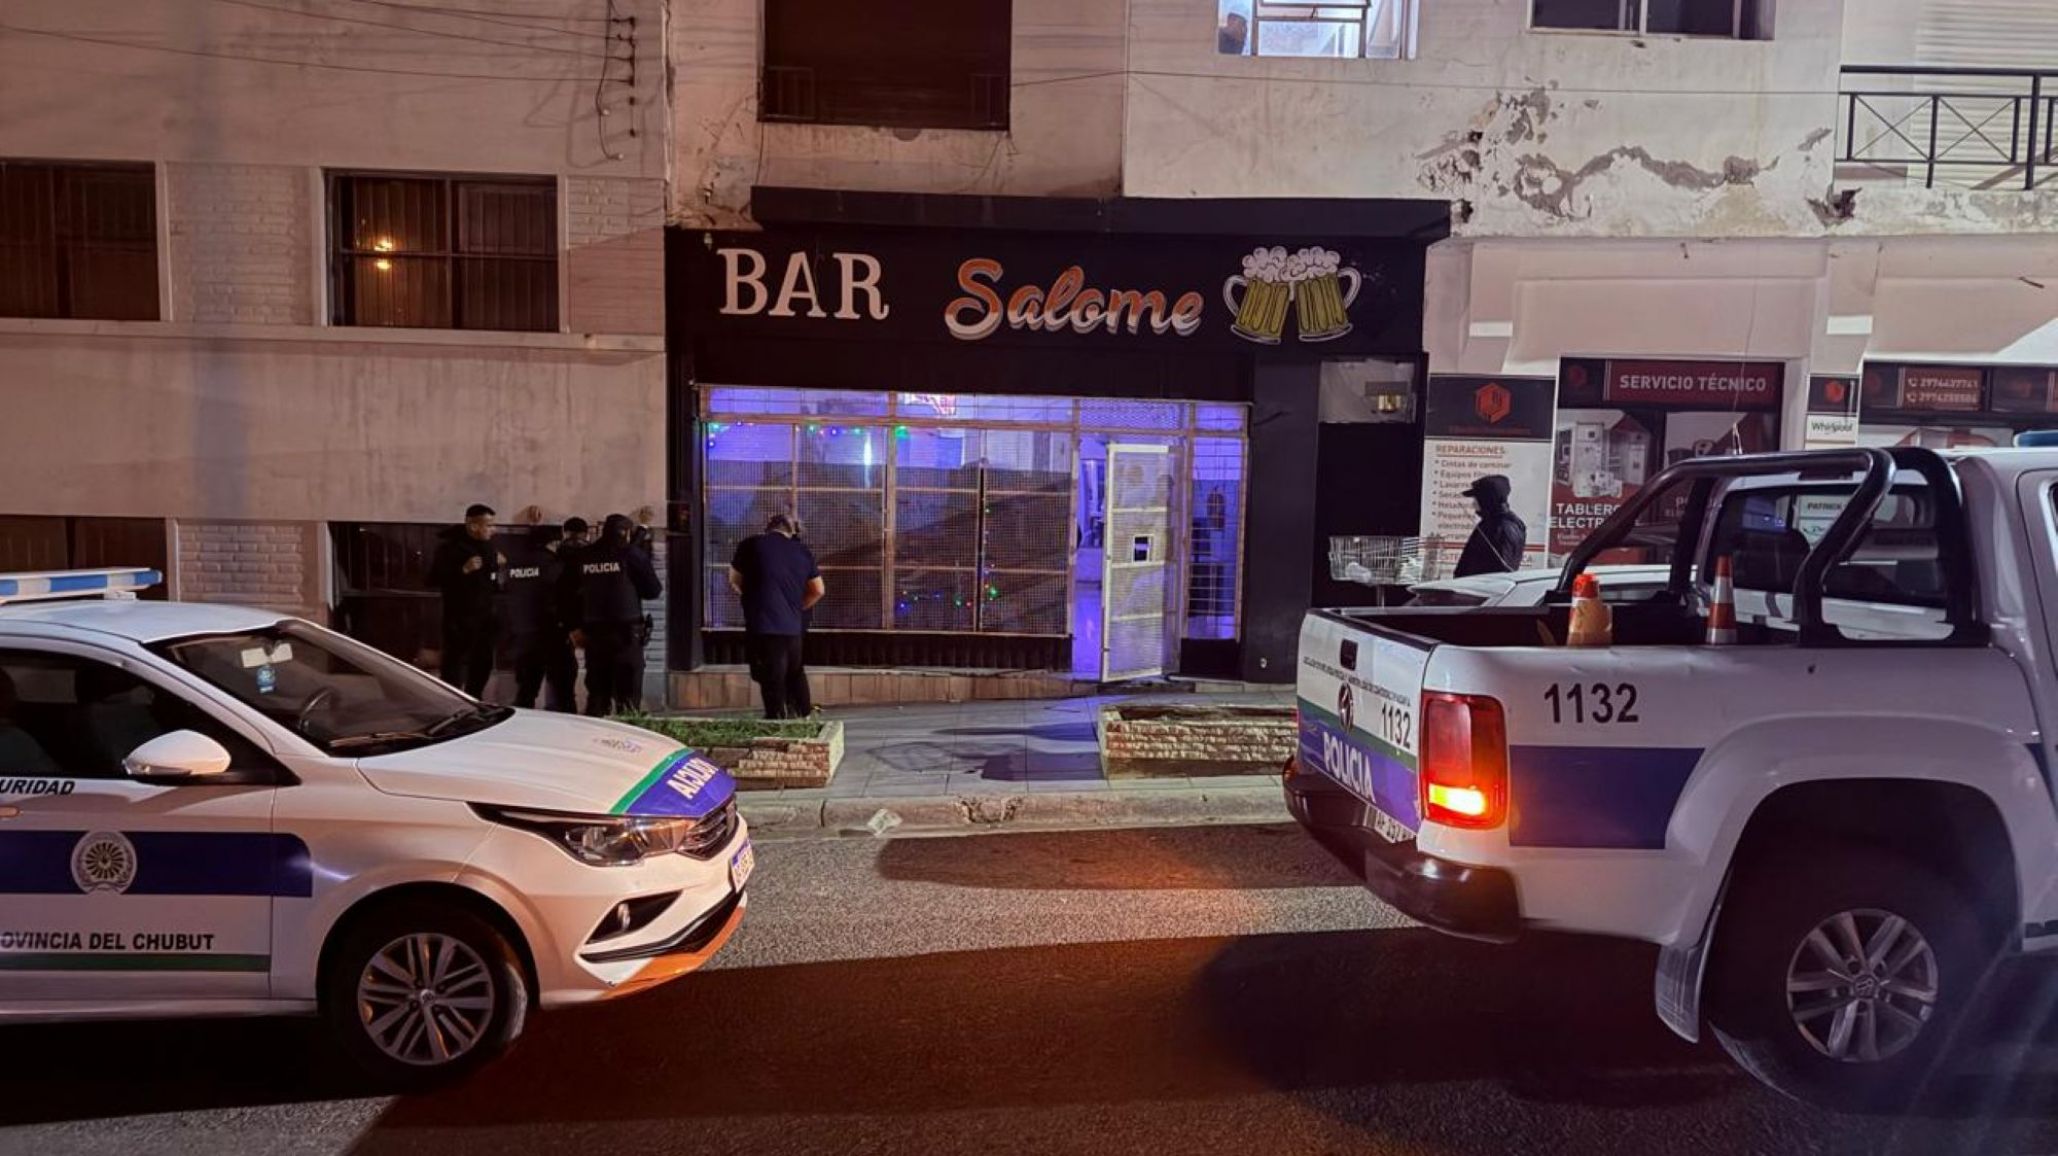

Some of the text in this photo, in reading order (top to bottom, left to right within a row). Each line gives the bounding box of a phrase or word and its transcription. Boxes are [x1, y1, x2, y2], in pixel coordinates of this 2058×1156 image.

[717, 247, 1204, 341] BAR Salome
[1620, 373, 1767, 391] SERVICIO TÉCNICO
[1811, 420, 1854, 434] Whirlpool
[1435, 444, 1506, 455] REPARACIONES
[1549, 516, 1605, 528] ELECTR
[509, 567, 539, 578] POLICIA
[583, 562, 621, 574] POLICIA
[1543, 683, 1639, 723] 1132
[1381, 702, 1411, 750] 1132
[1323, 731, 1376, 804] POLICIA
[89, 933, 126, 950] DEL
[132, 934, 215, 950] CHUBUT
